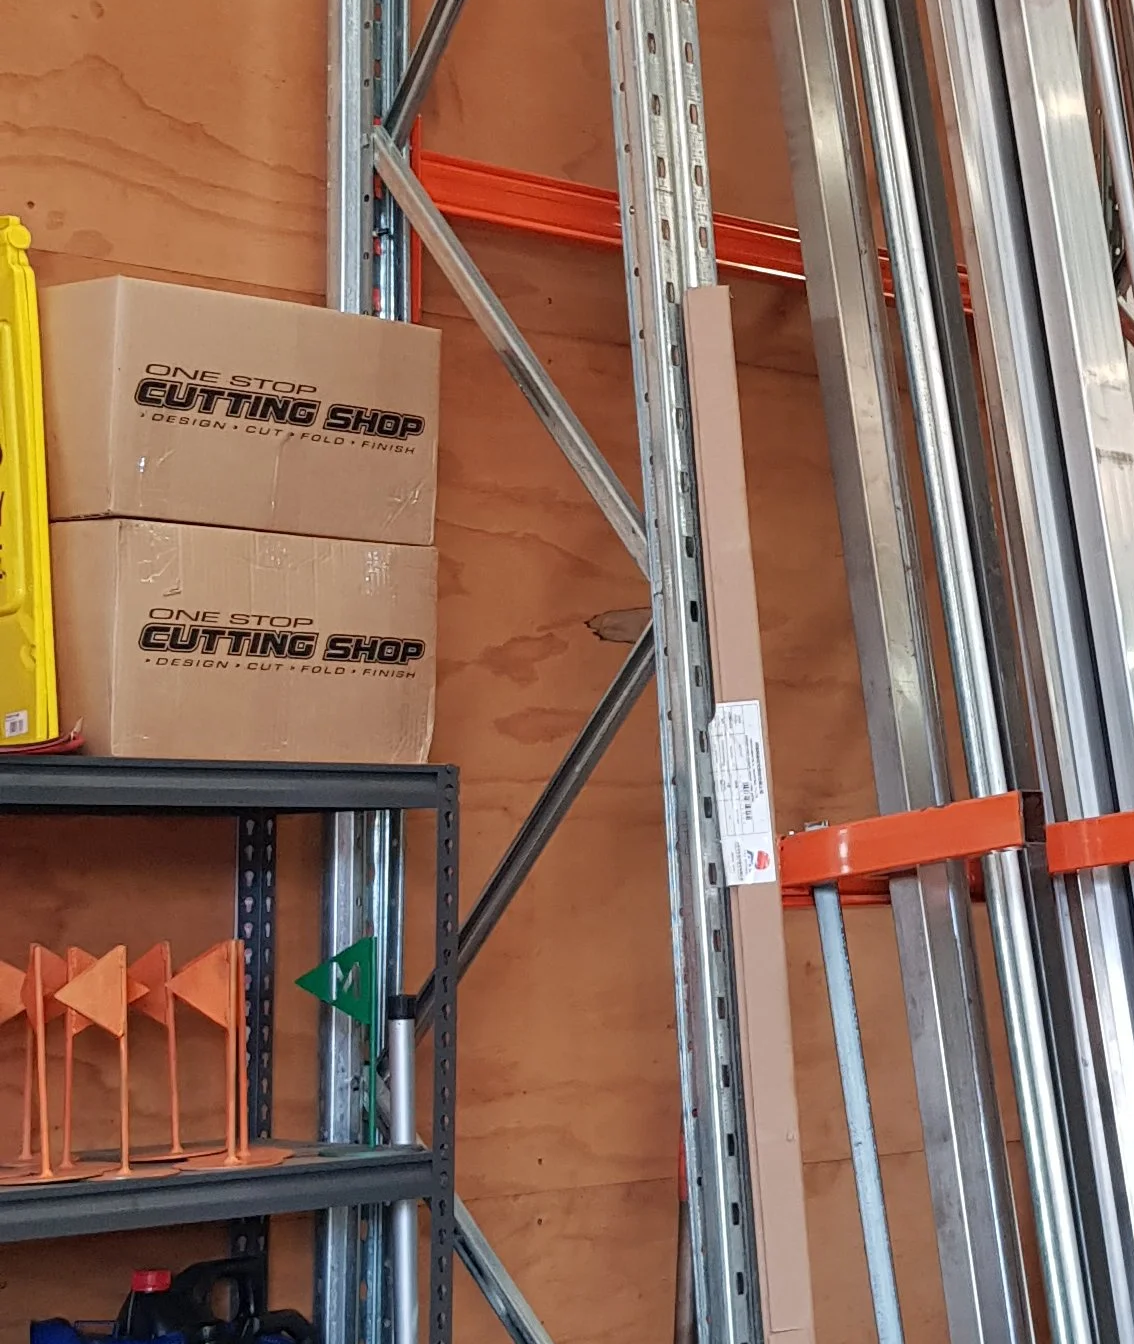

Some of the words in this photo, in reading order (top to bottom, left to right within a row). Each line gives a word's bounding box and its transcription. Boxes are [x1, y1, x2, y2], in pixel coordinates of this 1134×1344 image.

[145, 363, 221, 383] ONE
[229, 375, 318, 395] STOP
[134, 377, 321, 427] CUTTING
[323, 404, 426, 440] SHOP
[152, 413, 227, 430] DESIGN
[245, 425, 284, 437] CUT
[300, 432, 345, 445] FOLD
[361, 441, 416, 454] FINISH
[149, 608, 221, 624] ONE
[229, 613, 314, 628] STOP
[138, 623, 319, 659] CUTTING
[323, 634, 426, 665] SHOP
[156, 657, 229, 669] DESIGN
[247, 662, 284, 672] CUT
[300, 665, 346, 675] FOLD
[363, 668, 416, 679] FINISH
